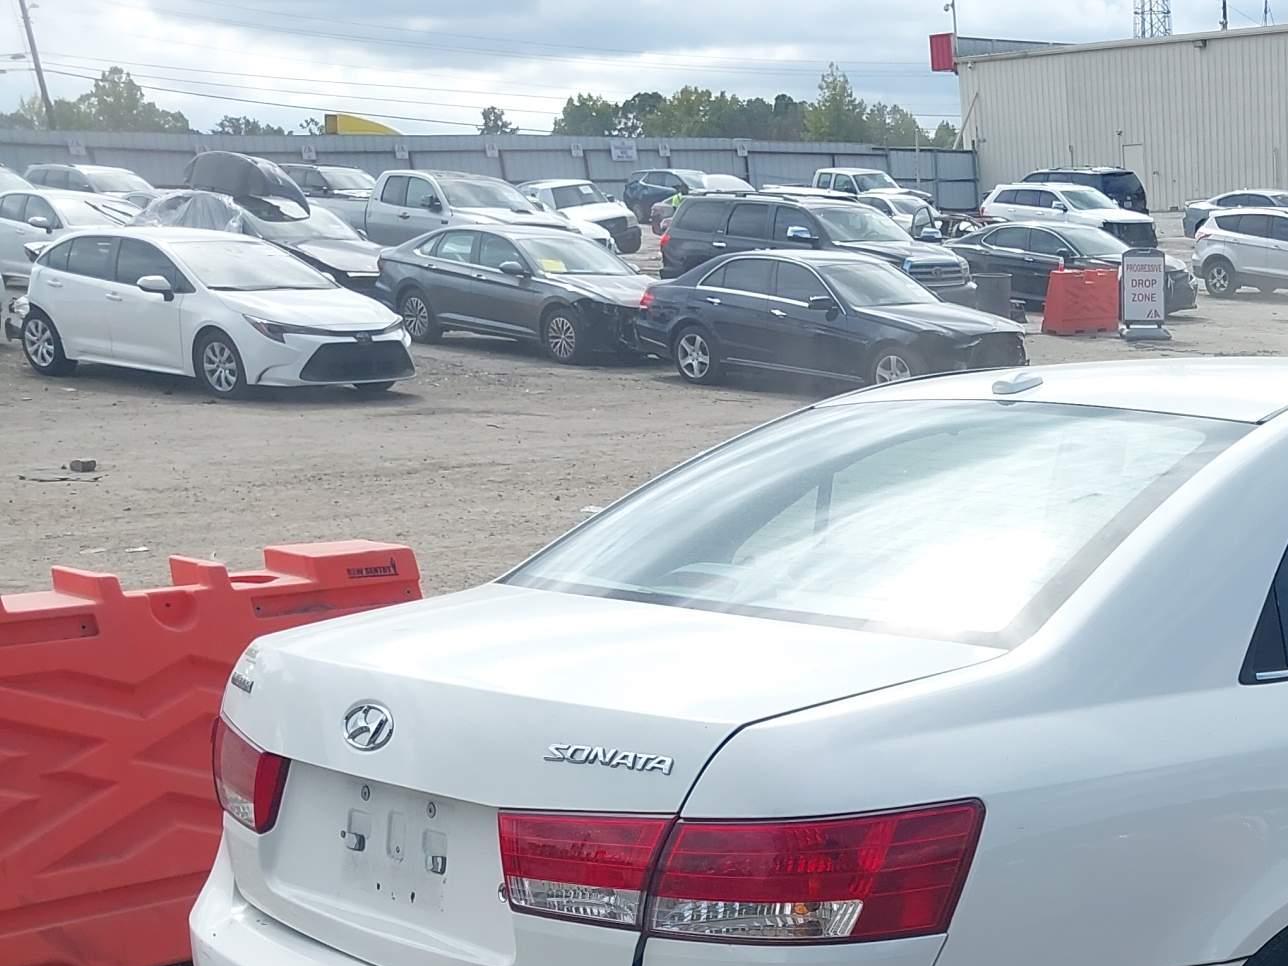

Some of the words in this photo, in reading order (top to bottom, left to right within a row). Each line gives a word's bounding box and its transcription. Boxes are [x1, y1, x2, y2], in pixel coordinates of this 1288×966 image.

[1126, 263, 1162, 273] PROGRESSIVE
[1131, 279, 1157, 289] DROP
[1131, 293, 1157, 303] ZONE
[543, 743, 674, 776] SONATA
